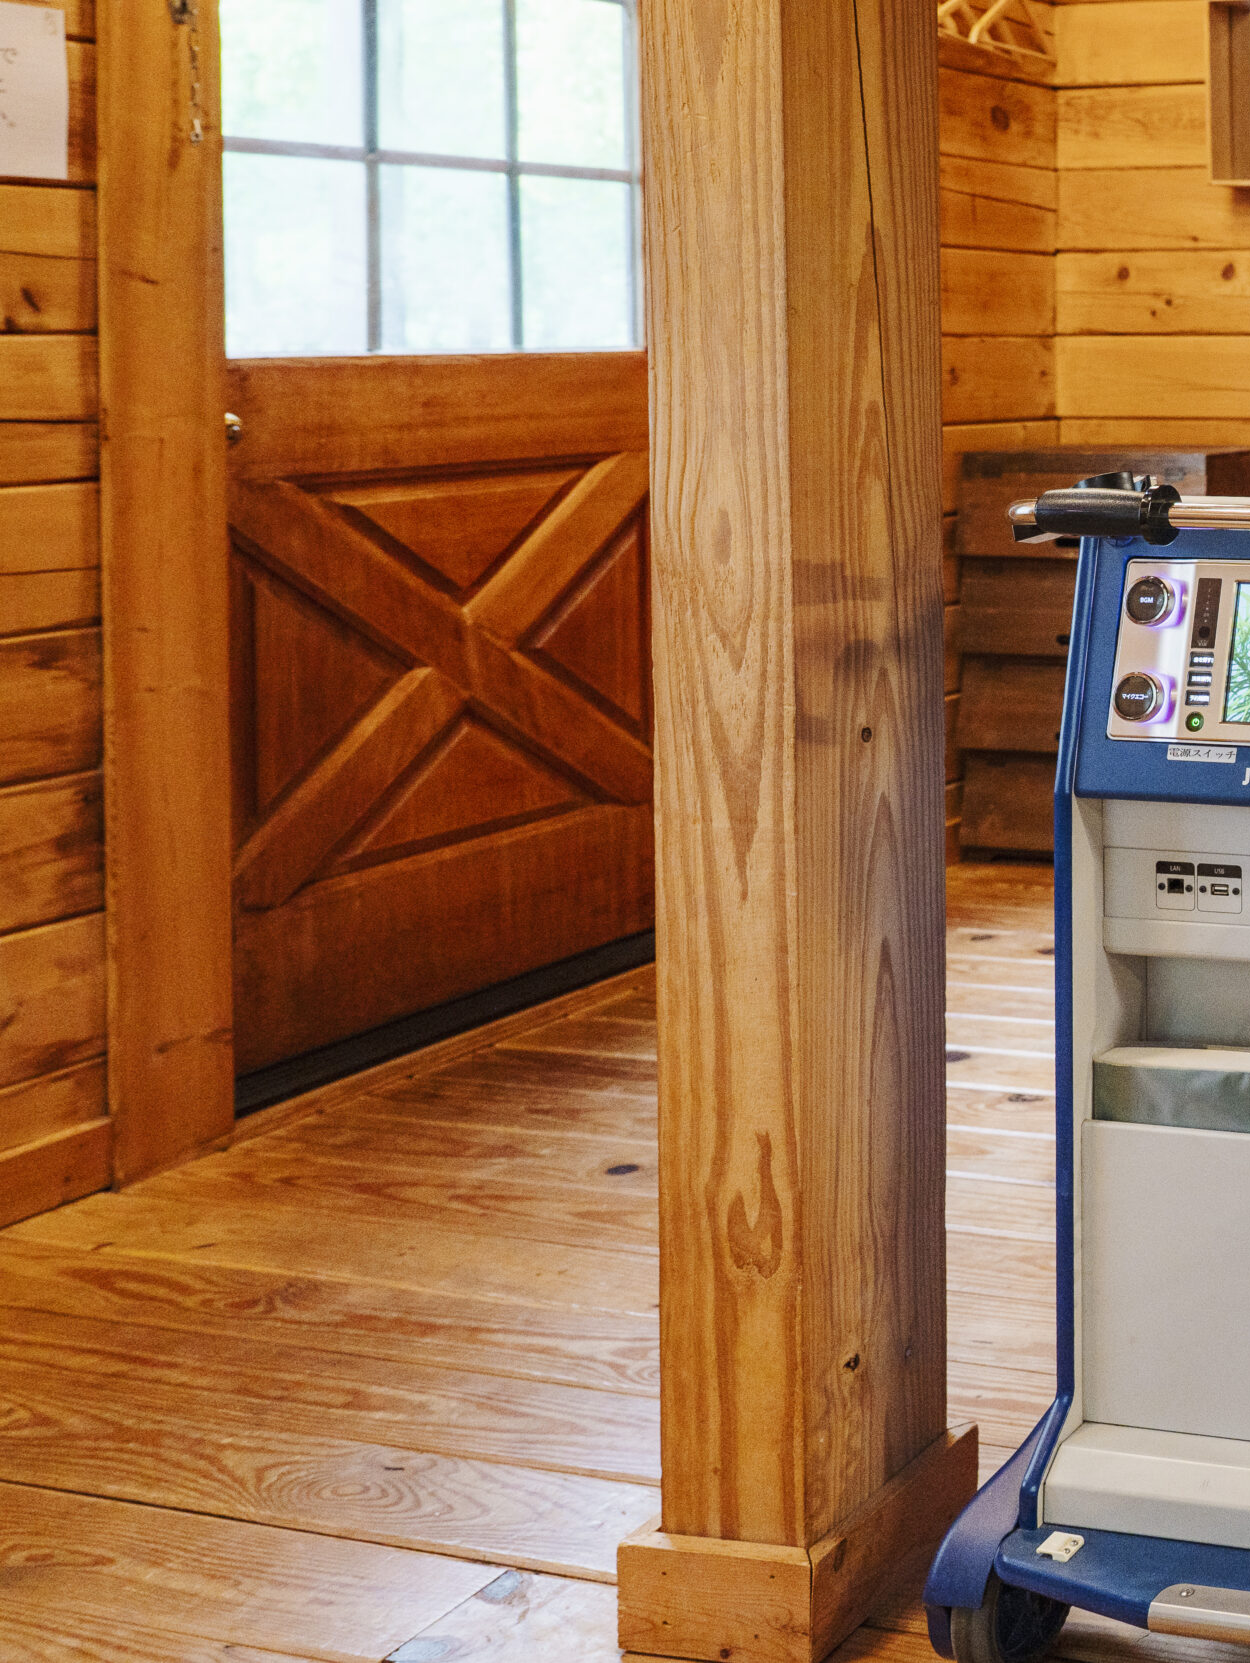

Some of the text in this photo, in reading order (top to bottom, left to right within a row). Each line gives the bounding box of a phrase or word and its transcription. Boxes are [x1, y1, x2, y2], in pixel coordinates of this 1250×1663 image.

[1139, 596, 1154, 604] BGM
[1121, 693, 1149, 701] マイクエコー
[1168, 746, 1236, 760] 電源スイッチ
